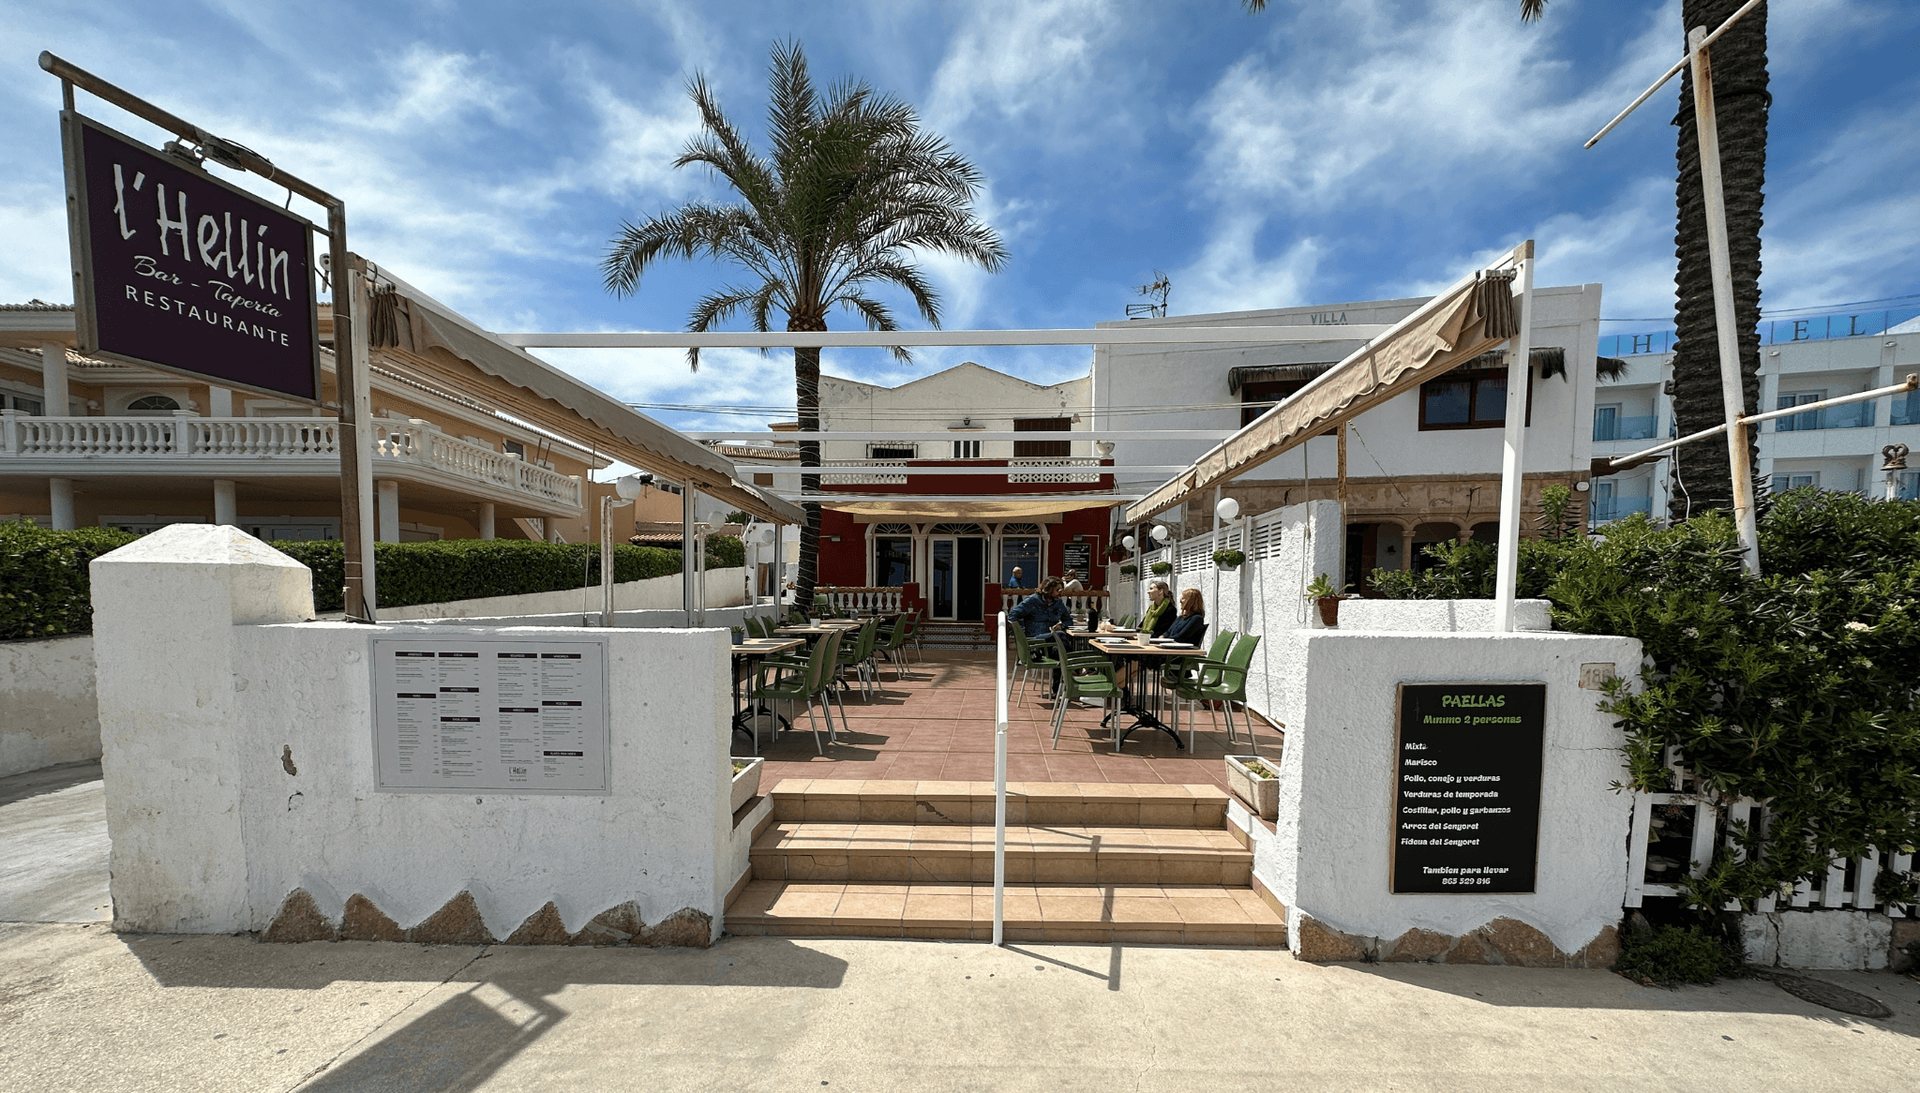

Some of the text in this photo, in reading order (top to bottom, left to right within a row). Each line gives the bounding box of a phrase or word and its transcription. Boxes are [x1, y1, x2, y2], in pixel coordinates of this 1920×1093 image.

[134, 255, 183, 285] Bar
[125, 285, 289, 347] RESTAURANTE
[1310, 311, 1347, 324] VILLA
[1442, 695, 1505, 707] PAELLAS
[1464, 715, 1471, 724] 2
[1473, 716, 1522, 725] personas
[1428, 775, 1455, 783] conejo
[1455, 791, 1498, 799] temporada
[1440, 807, 1461, 815] pollo
[1469, 807, 1511, 815] garbanzos
[1402, 822, 1479, 831] Arroz del Senyoret
[1443, 838, 1480, 847] Senyoret
[1423, 866, 1509, 876] Tambien para llevar
